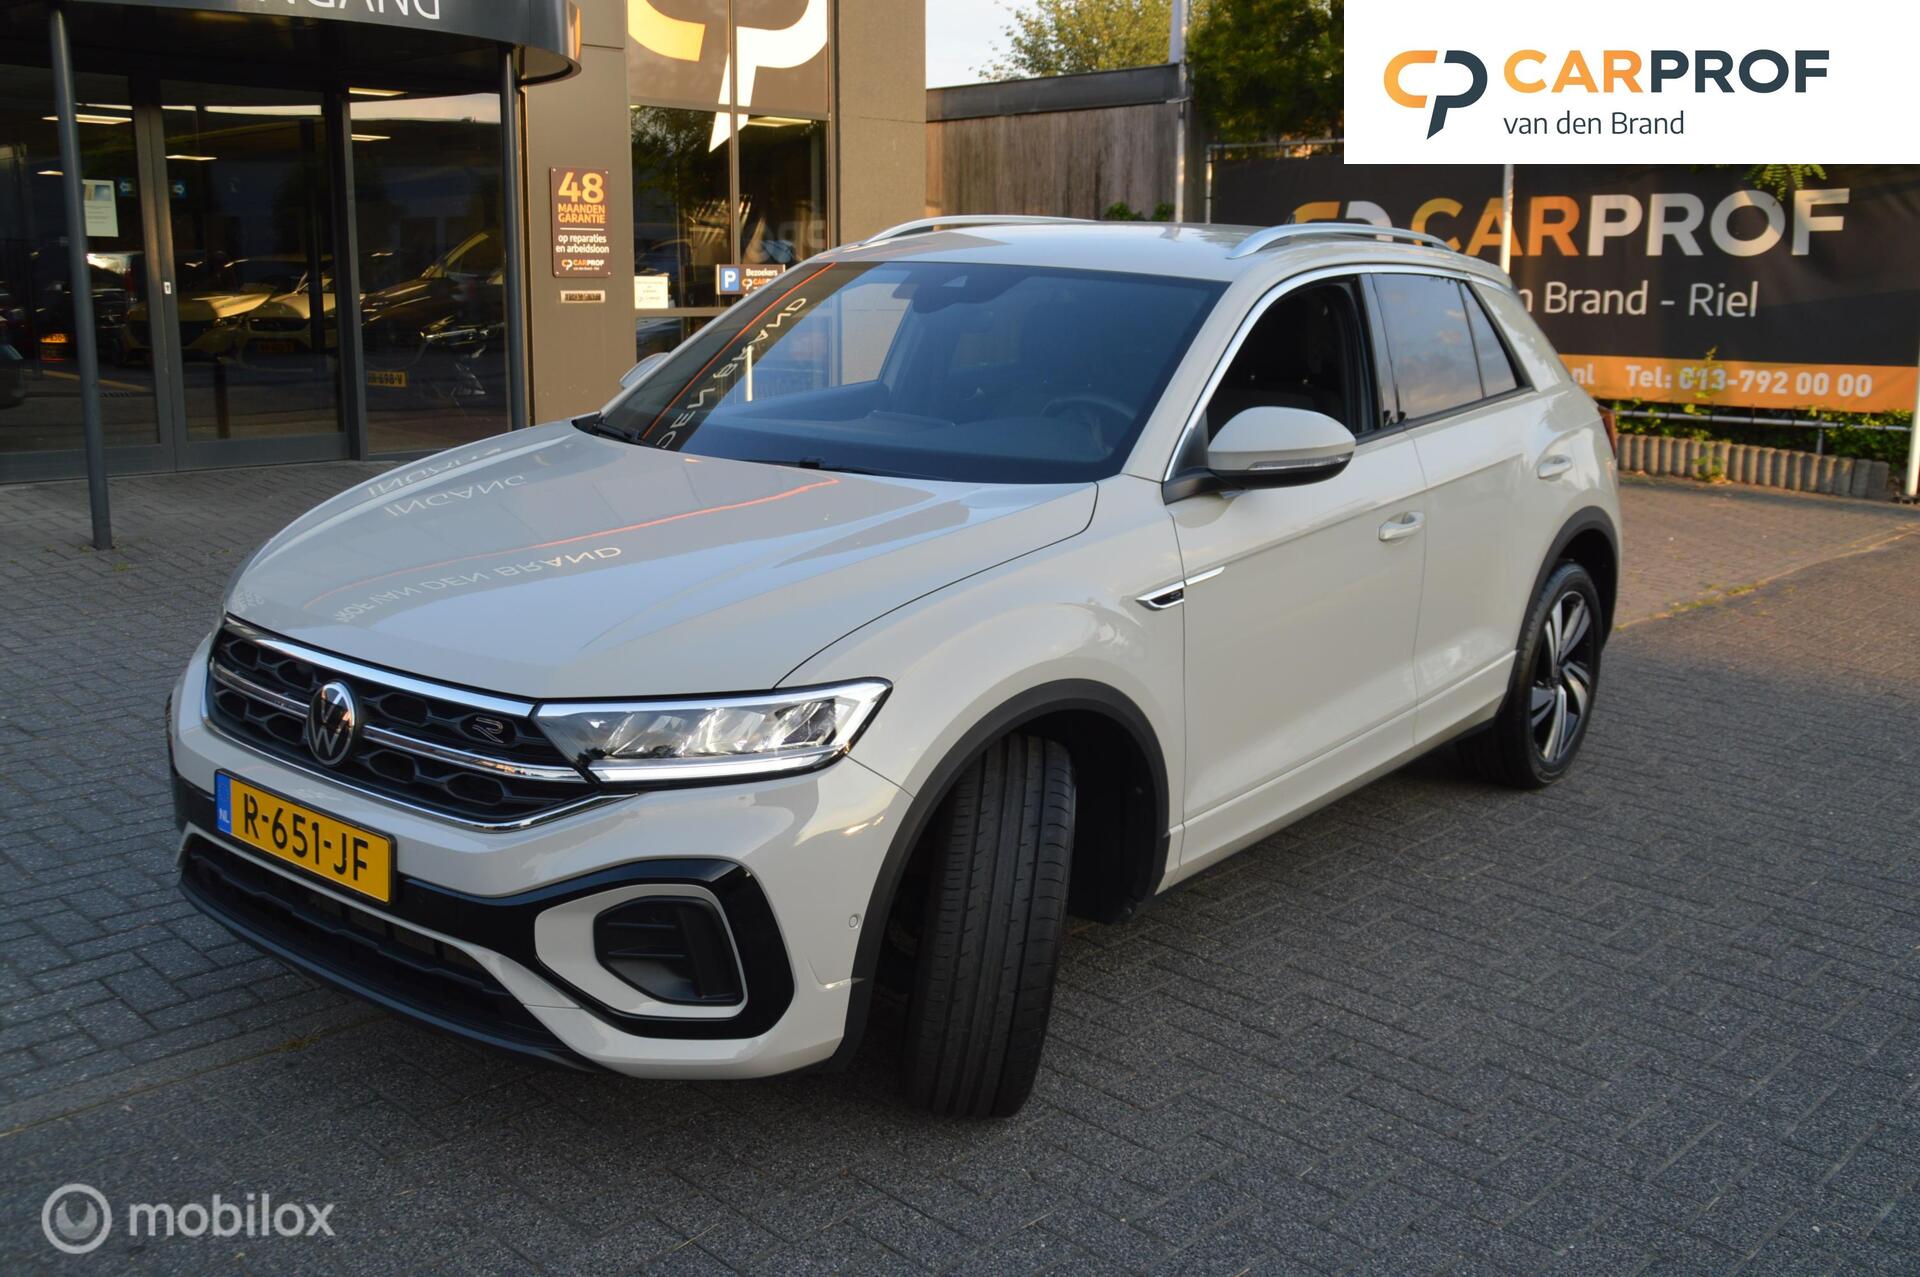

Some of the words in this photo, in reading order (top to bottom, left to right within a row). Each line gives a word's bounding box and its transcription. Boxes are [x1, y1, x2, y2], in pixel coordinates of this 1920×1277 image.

[558, 171, 604, 204] 48
[558, 203, 606, 214] MAANDEN
[558, 212, 606, 224] GARANTIE
[1411, 187, 1850, 257] CARPROF
[555, 245, 566, 253] en
[567, 244, 610, 253] arbeidsloon
[558, 234, 568, 244] op
[570, 234, 607, 244] reparaties
[746, 268, 778, 276] Bezoekers
[1544, 280, 1648, 316] Brand
[1688, 281, 1759, 317] Riel
[1626, 365, 1672, 388] Tel:
[1795, 372, 1830, 395] 00
[1837, 373, 1873, 397] 00
[243, 792, 369, 882] R-651-JF
